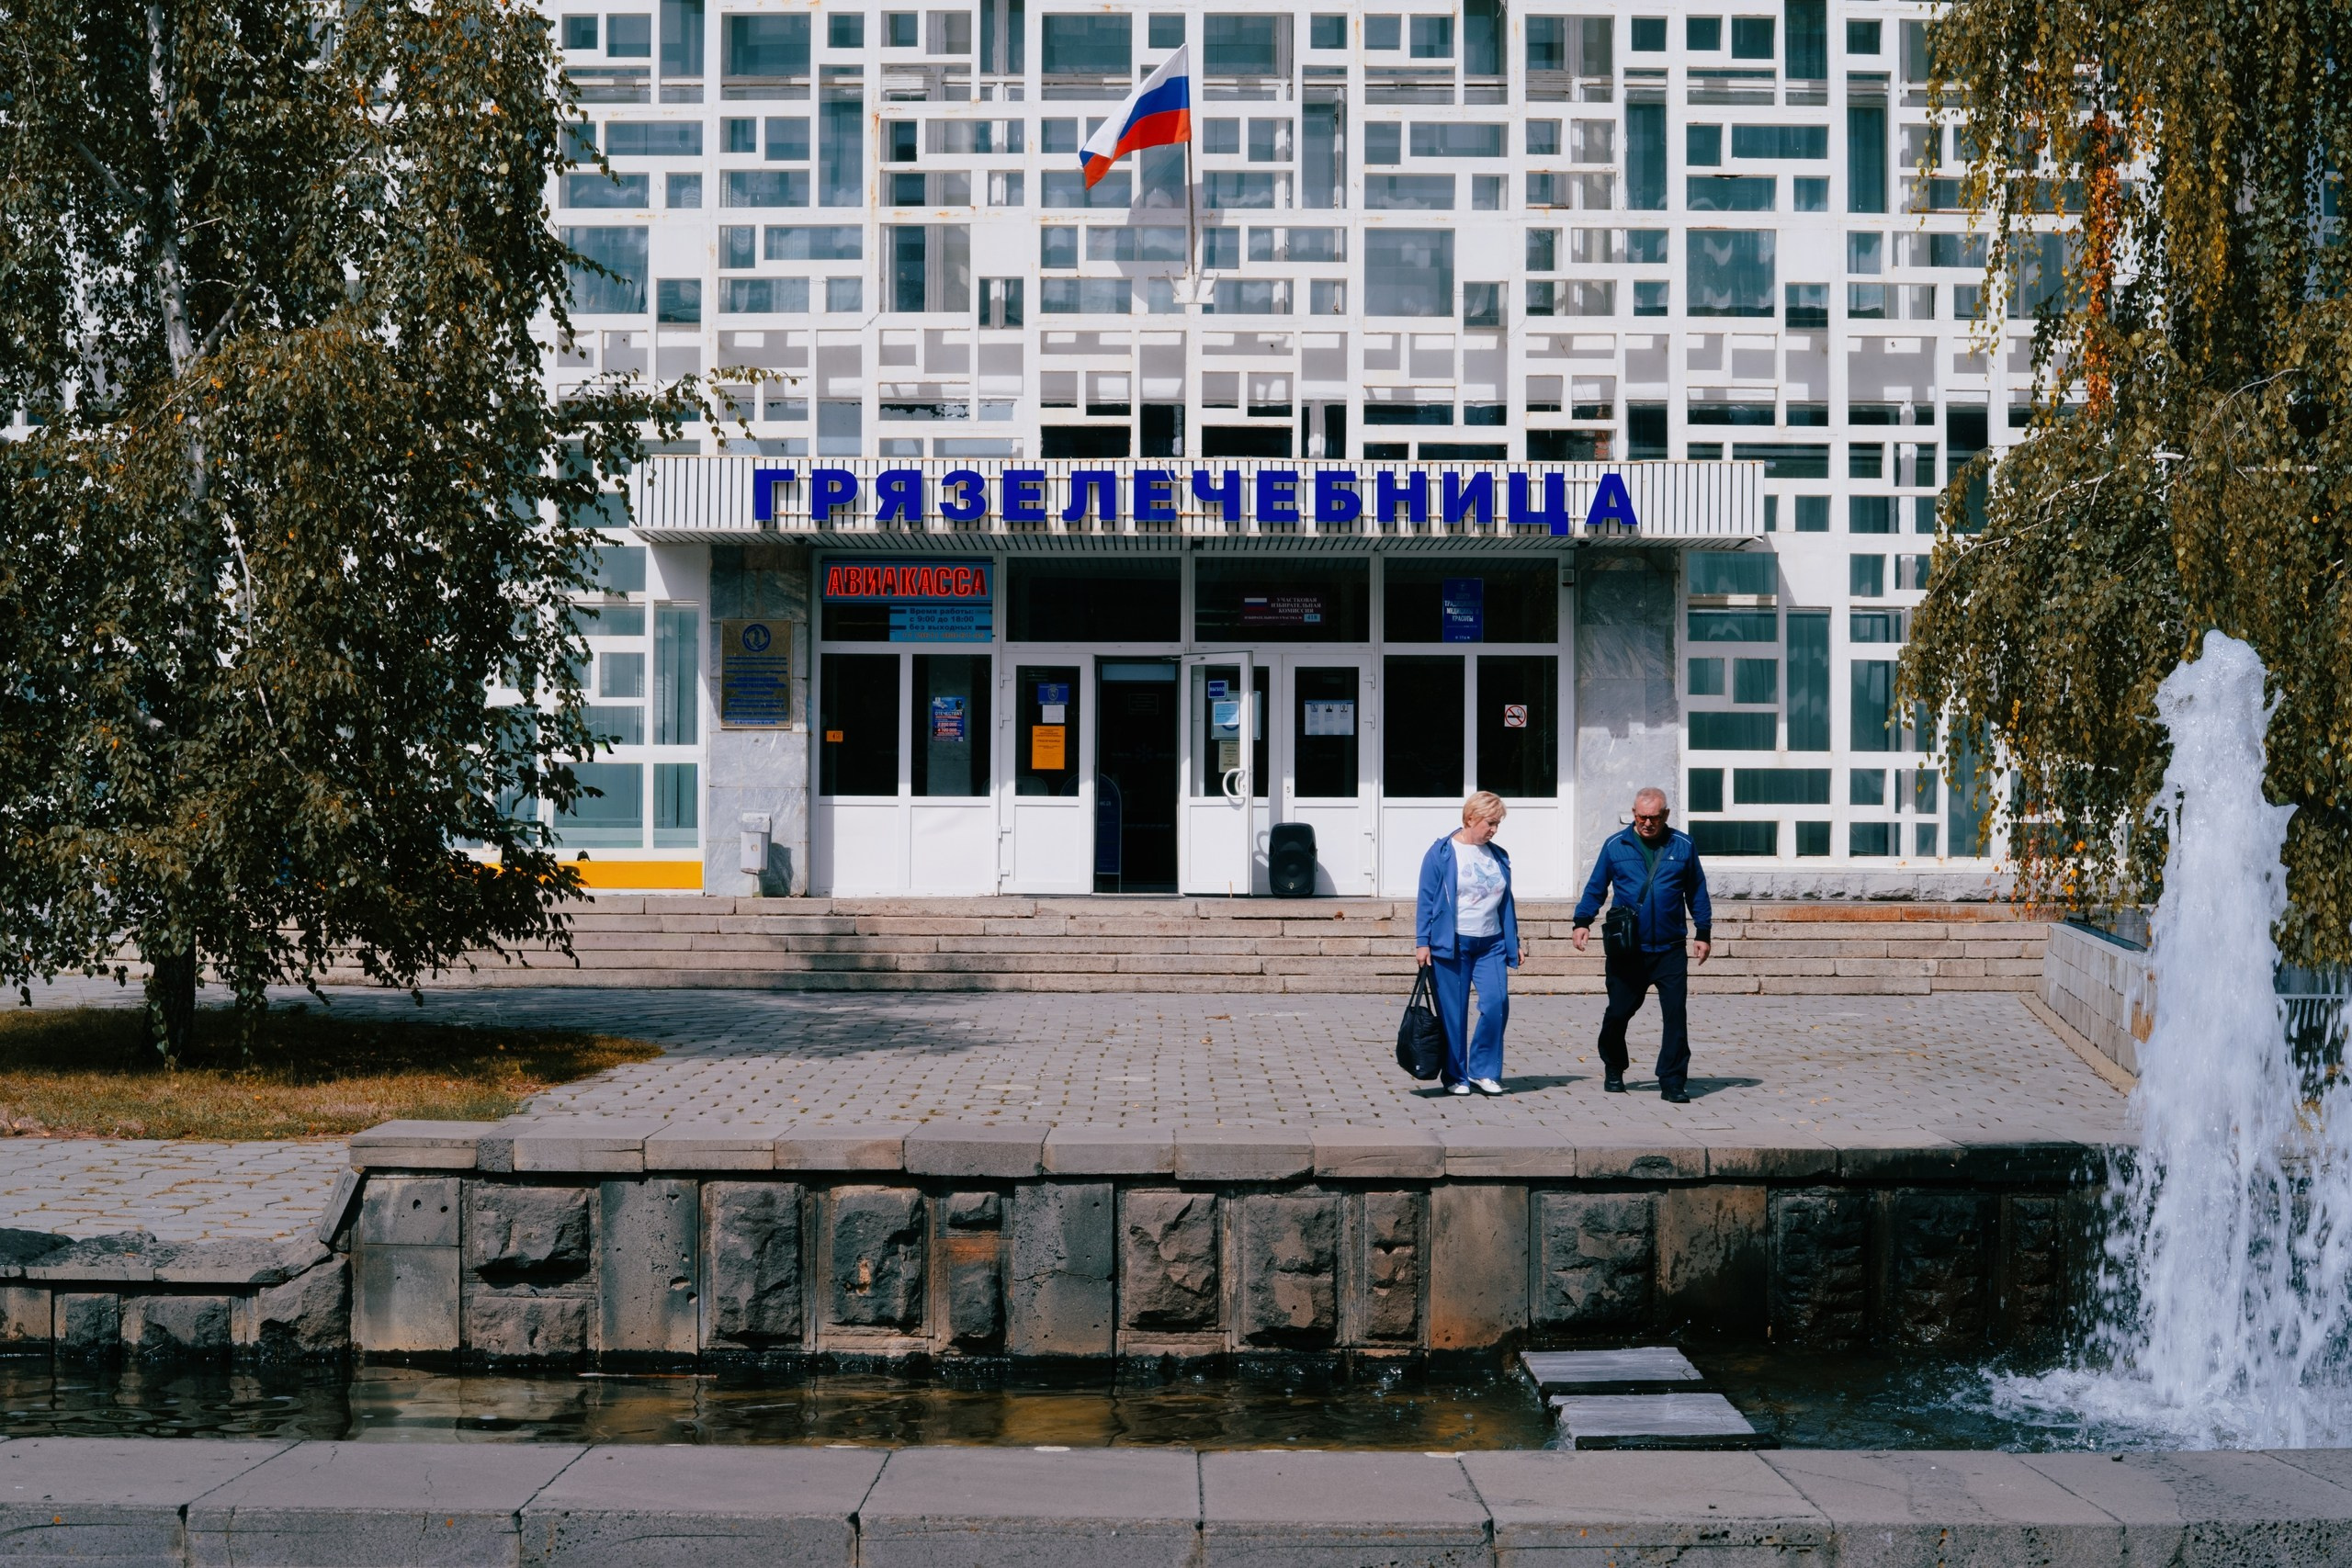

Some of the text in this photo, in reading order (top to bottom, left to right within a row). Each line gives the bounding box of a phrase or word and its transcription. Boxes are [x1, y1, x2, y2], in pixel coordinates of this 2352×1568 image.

[753, 468, 1638, 536] ГРЯЗЕЛЕЧЕБНИЦА
[826, 567, 987, 596] АВИАКАССА
[910, 607, 975, 616] Время работы:
